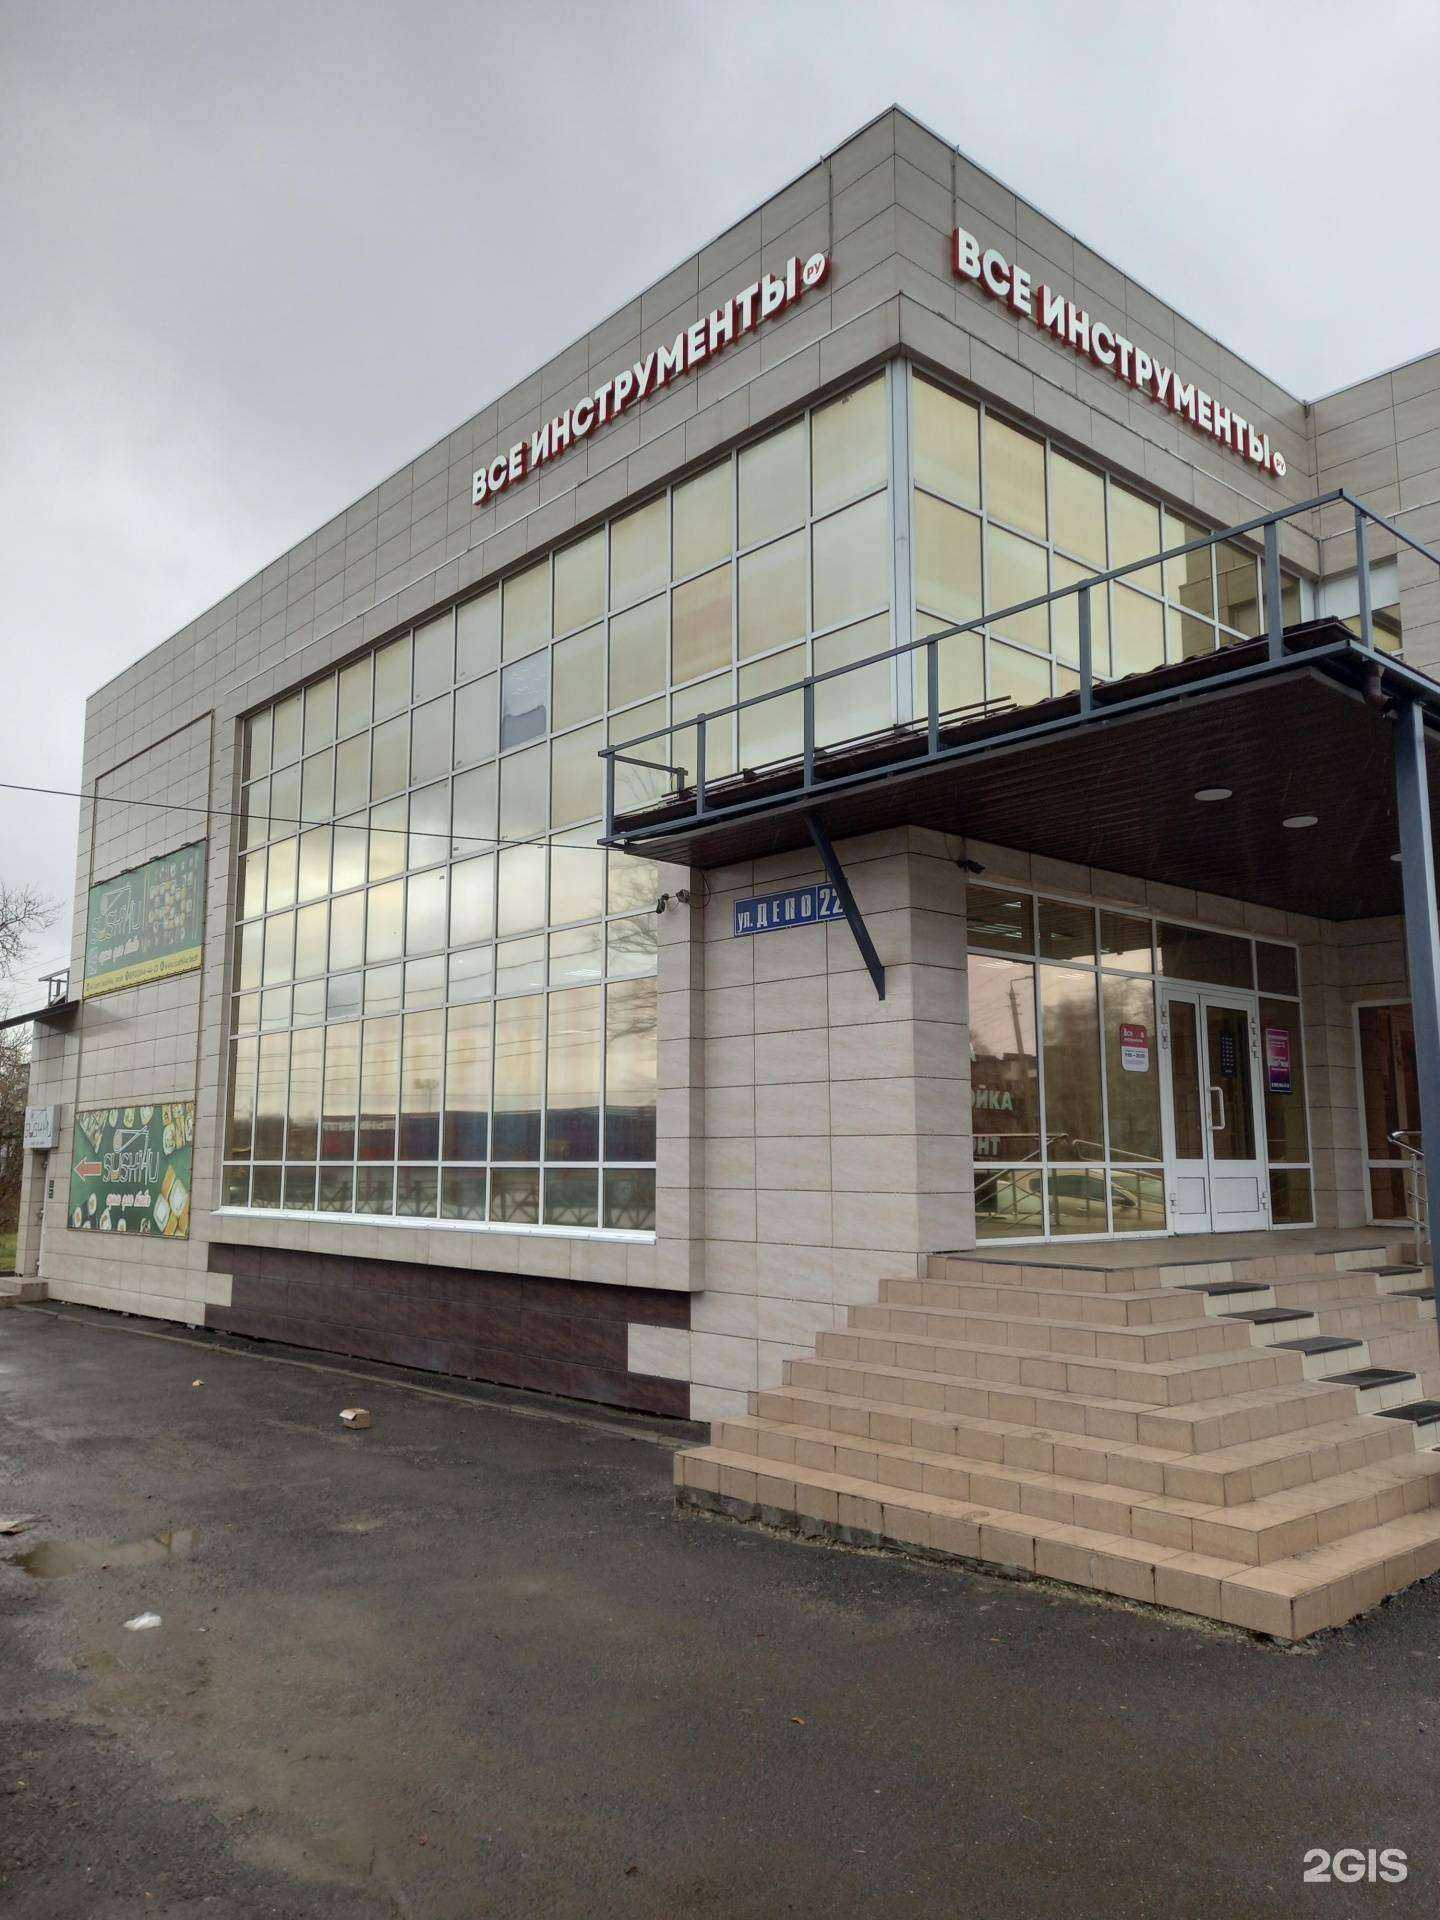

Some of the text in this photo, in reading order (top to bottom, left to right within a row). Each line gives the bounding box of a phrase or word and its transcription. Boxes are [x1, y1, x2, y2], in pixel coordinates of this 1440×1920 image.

[472, 440, 525, 505] ВСЕ
[530, 256, 799, 469] ИНСТРУМЕНТЫ
[956, 226, 1032, 315] ВСЕ
[1042, 284, 1271, 469] ИНСТРУМЕНТЫ
[738, 888, 843, 933] ул. ДЕПО 22
[974, 1135, 1000, 1156] НТ
